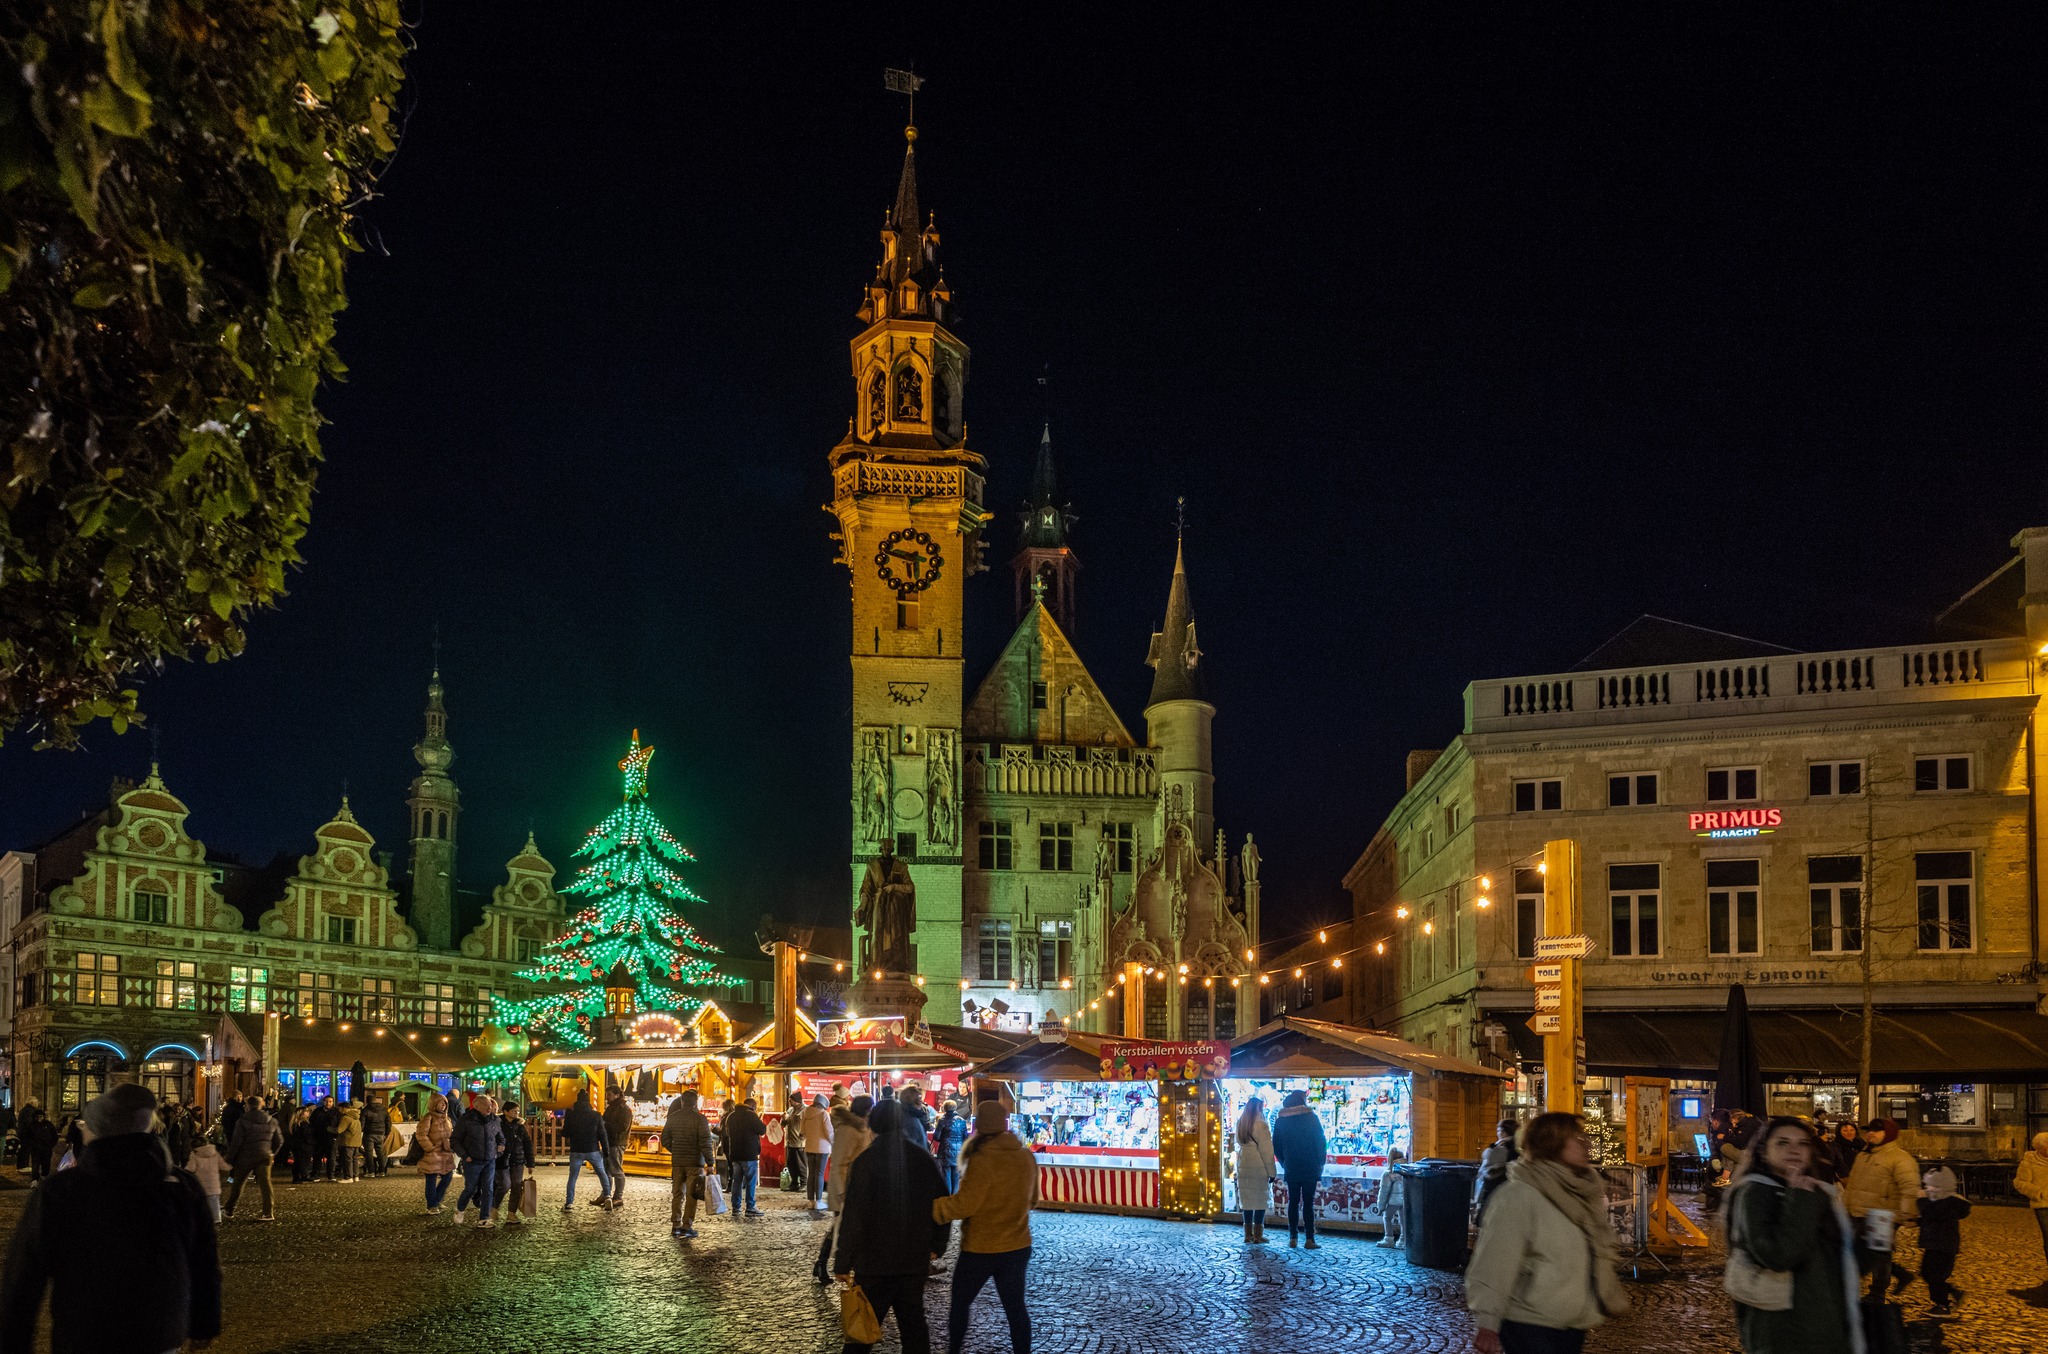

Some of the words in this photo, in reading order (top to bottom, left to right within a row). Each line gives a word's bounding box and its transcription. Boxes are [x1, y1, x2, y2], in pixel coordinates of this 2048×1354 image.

[1689, 809, 1782, 830] PRIMUS
[1712, 829, 1759, 838] HAACHT
[1540, 942, 1582, 951] KERSTCIRCUS
[1537, 969, 1561, 977] TOILE
[1717, 971, 1740, 980] van
[1744, 968, 1828, 982] Egmont
[936, 1044, 967, 1060] ESCARGOTS
[1113, 1045, 1175, 1057] Kerstballen
[1178, 1045, 1214, 1055] vissen
